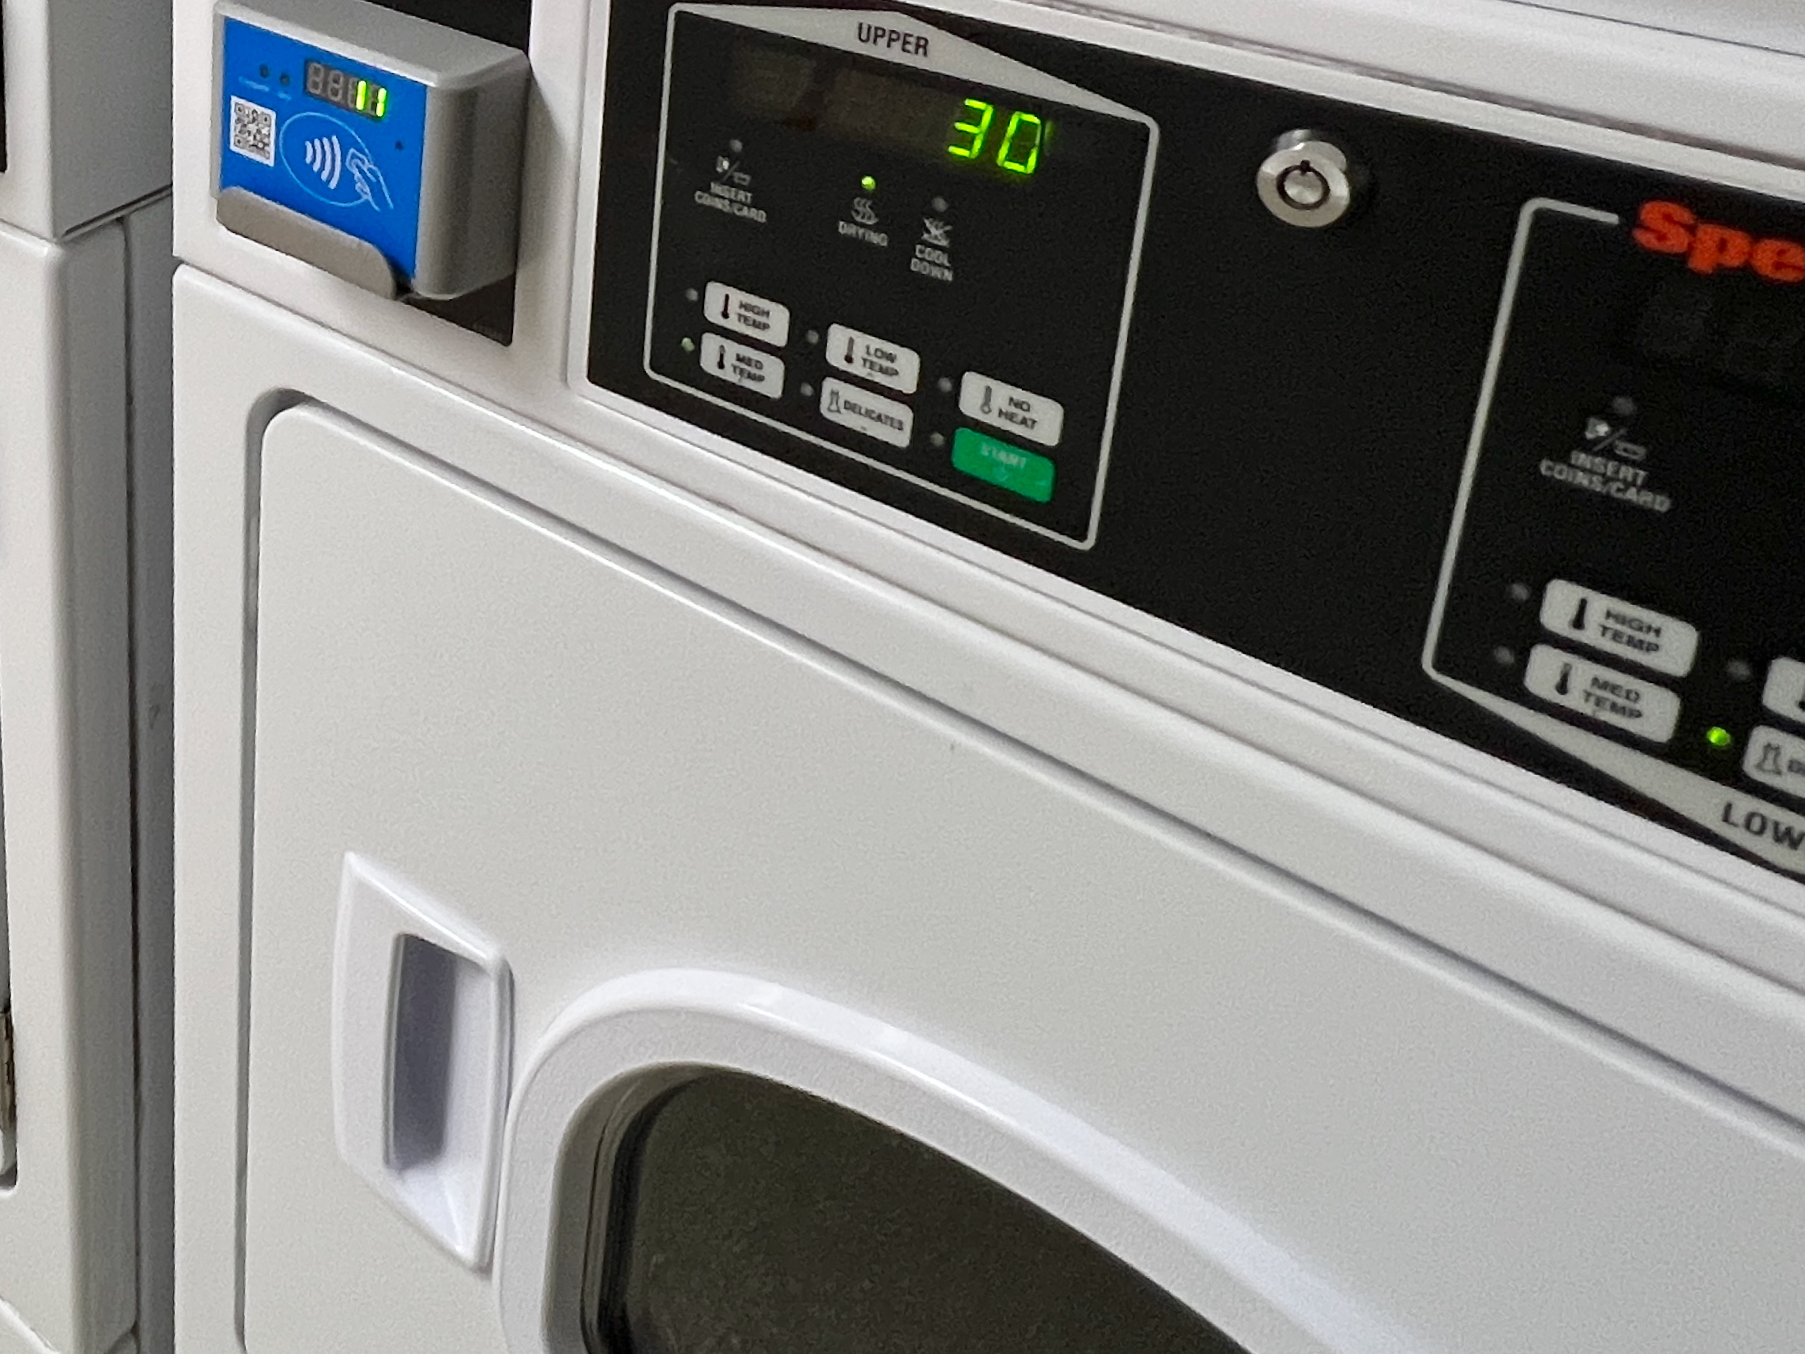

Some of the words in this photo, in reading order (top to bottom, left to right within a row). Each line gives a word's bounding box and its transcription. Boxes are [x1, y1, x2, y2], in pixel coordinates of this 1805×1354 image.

[857, 22, 929, 57] UPPER
[948, 98, 1041, 174] 30
[710, 181, 752, 204] INSERT
[694, 190, 767, 223] COINS/CARD
[838, 221, 888, 246] DRYING
[1632, 199, 1805, 284] Spe
[915, 244, 951, 266] COOL
[910, 257, 953, 282] DOWN
[737, 312, 771, 332] TEMP
[738, 300, 770, 319] HIGH
[735, 352, 764, 371] MED
[861, 357, 900, 377] TEMP
[865, 344, 897, 364] LOW
[730, 363, 765, 383] TEMP
[843, 400, 904, 431] DELICATES
[1008, 396, 1031, 412] NO
[998, 408, 1038, 430] HEAT
[1570, 450, 1649, 487] INSERT
[1539, 458, 1672, 514] COINS/CARD
[1604, 609, 1662, 640] HIGH
[1597, 623, 1661, 656] TEMP
[1590, 676, 1641, 704] MED
[1582, 689, 1643, 721] TEMP
[1721, 801, 1805, 852] LOW
